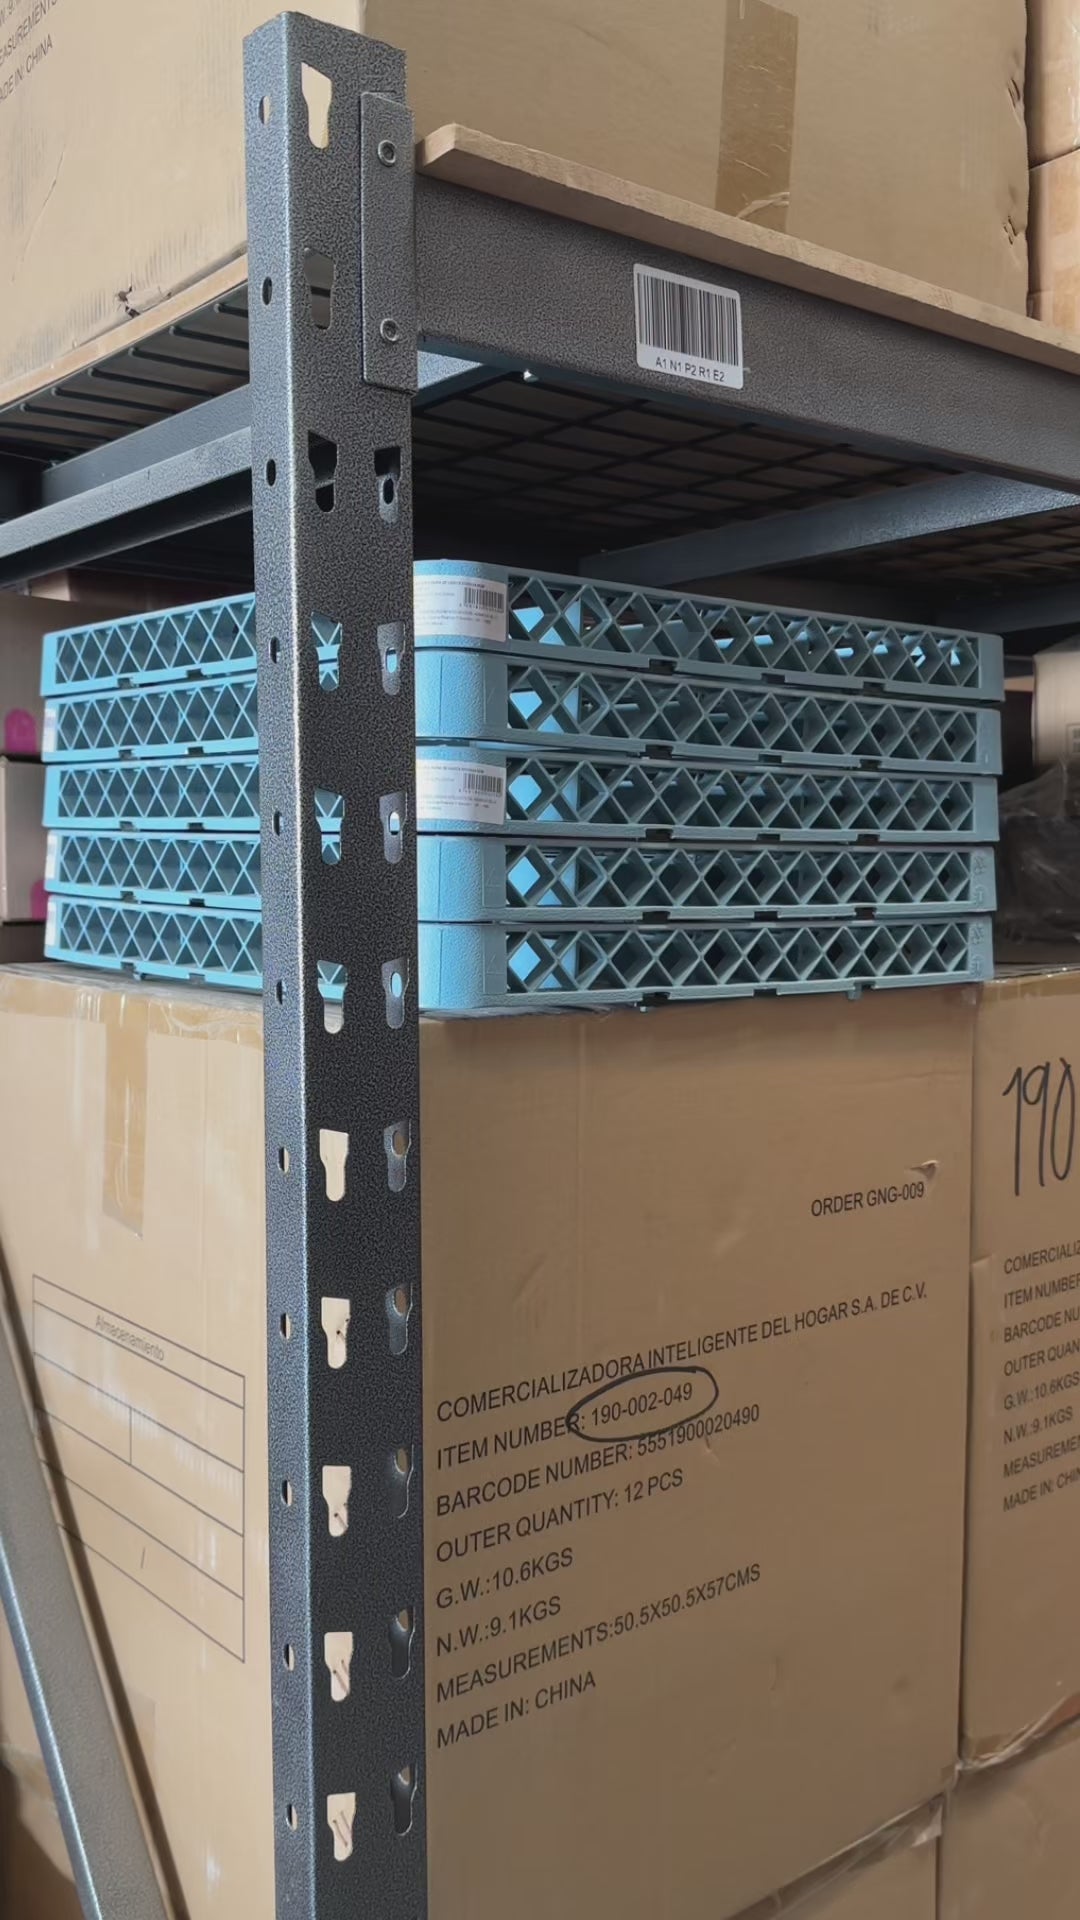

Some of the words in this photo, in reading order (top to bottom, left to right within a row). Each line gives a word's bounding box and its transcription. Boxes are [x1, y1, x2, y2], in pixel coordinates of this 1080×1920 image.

[25, 33, 53, 73] CHINA
[656, 357, 667, 369] A1
[669, 361, 682, 373] N1
[685, 363, 697, 376] P2
[699, 367, 711, 379] R1
[714, 370, 725, 382] E2
[1002, 1057, 1075, 1197] 190
[811, 1192, 863, 1217] ORDER
[866, 1181, 925, 1207] GNG-009
[1004, 1285, 1032, 1309] ITEM
[1004, 1312, 1061, 1342] BARCODE
[437, 1353, 645, 1422] COMERCIALIZADORA
[648, 1324, 758, 1370] INTELIGENTE
[761, 1317, 792, 1339] DEL
[795, 1302, 849, 1331] HOGAR
[851, 1296, 878, 1316] S.A.
[881, 1289, 900, 1308] DE
[903, 1282, 928, 1303] C.V.
[1004, 1350, 1045, 1376] OUTER
[437, 1437, 488, 1470] ITEM
[494, 1412, 585, 1453] NUMBER:
[591, 1381, 693, 1427] 190-002-049
[437, 1468, 541, 1517] BARCODE
[546, 1442, 634, 1485] NUMBER:
[637, 1404, 760, 1457] 5551900020490
[437, 1523, 511, 1563] OUTER
[515, 1488, 620, 1538] QUANTITY:
[624, 1480, 644, 1503] 12
[648, 1468, 684, 1496] PCS
[1003, 1485, 1037, 1512] MADE
[437, 1547, 574, 1609] G.W.:10.6KGS
[437, 1595, 561, 1656] N.W.:9.1KGS
[437, 1563, 761, 1703] MEASUREMENTS:50.5X50.5X57CMS
[437, 1707, 499, 1749] MADE
[504, 1696, 530, 1723] IN:
[535, 1670, 596, 1709] CHINA
